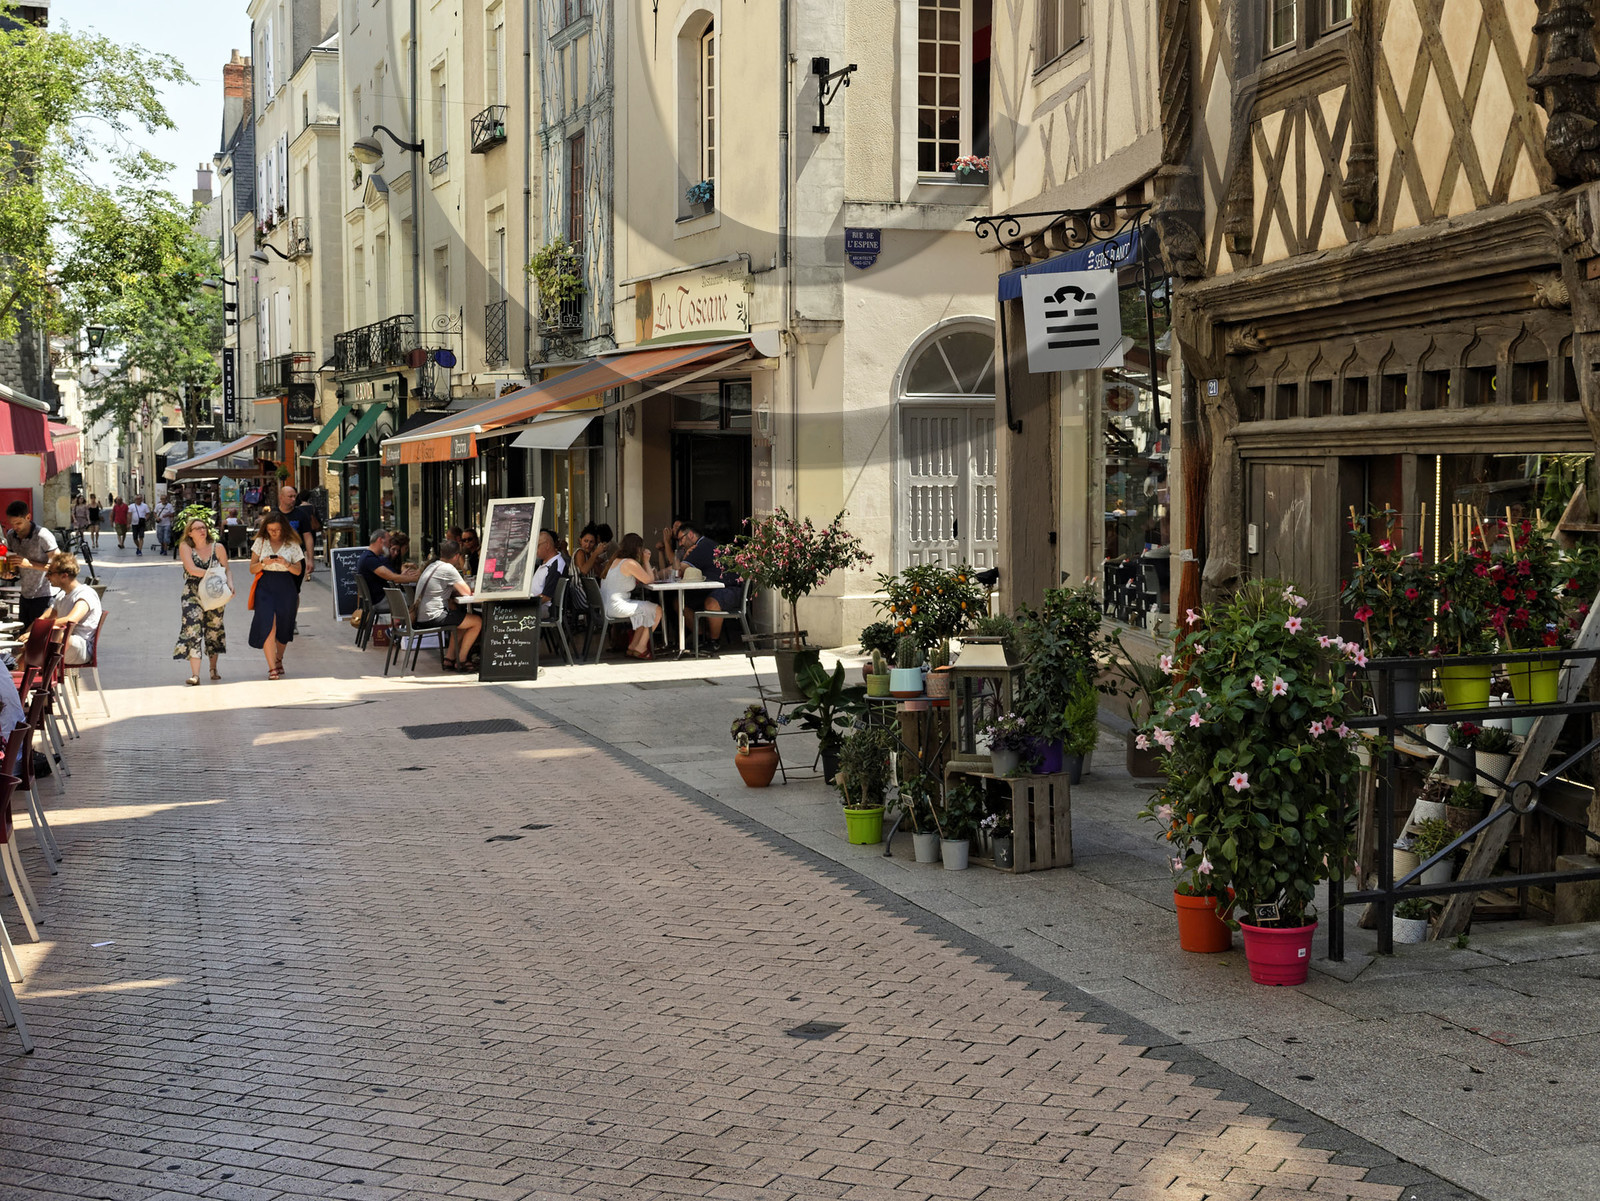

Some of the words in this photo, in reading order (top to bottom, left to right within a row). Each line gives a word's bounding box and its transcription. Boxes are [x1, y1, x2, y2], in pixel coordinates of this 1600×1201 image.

[866, 232, 875, 240] DE
[847, 240, 879, 249] L'ESPINE
[654, 293, 673, 334] La
[676, 285, 728, 330] Toscane
[226, 359, 231, 372] LE
[1209, 381, 1216, 394] 21
